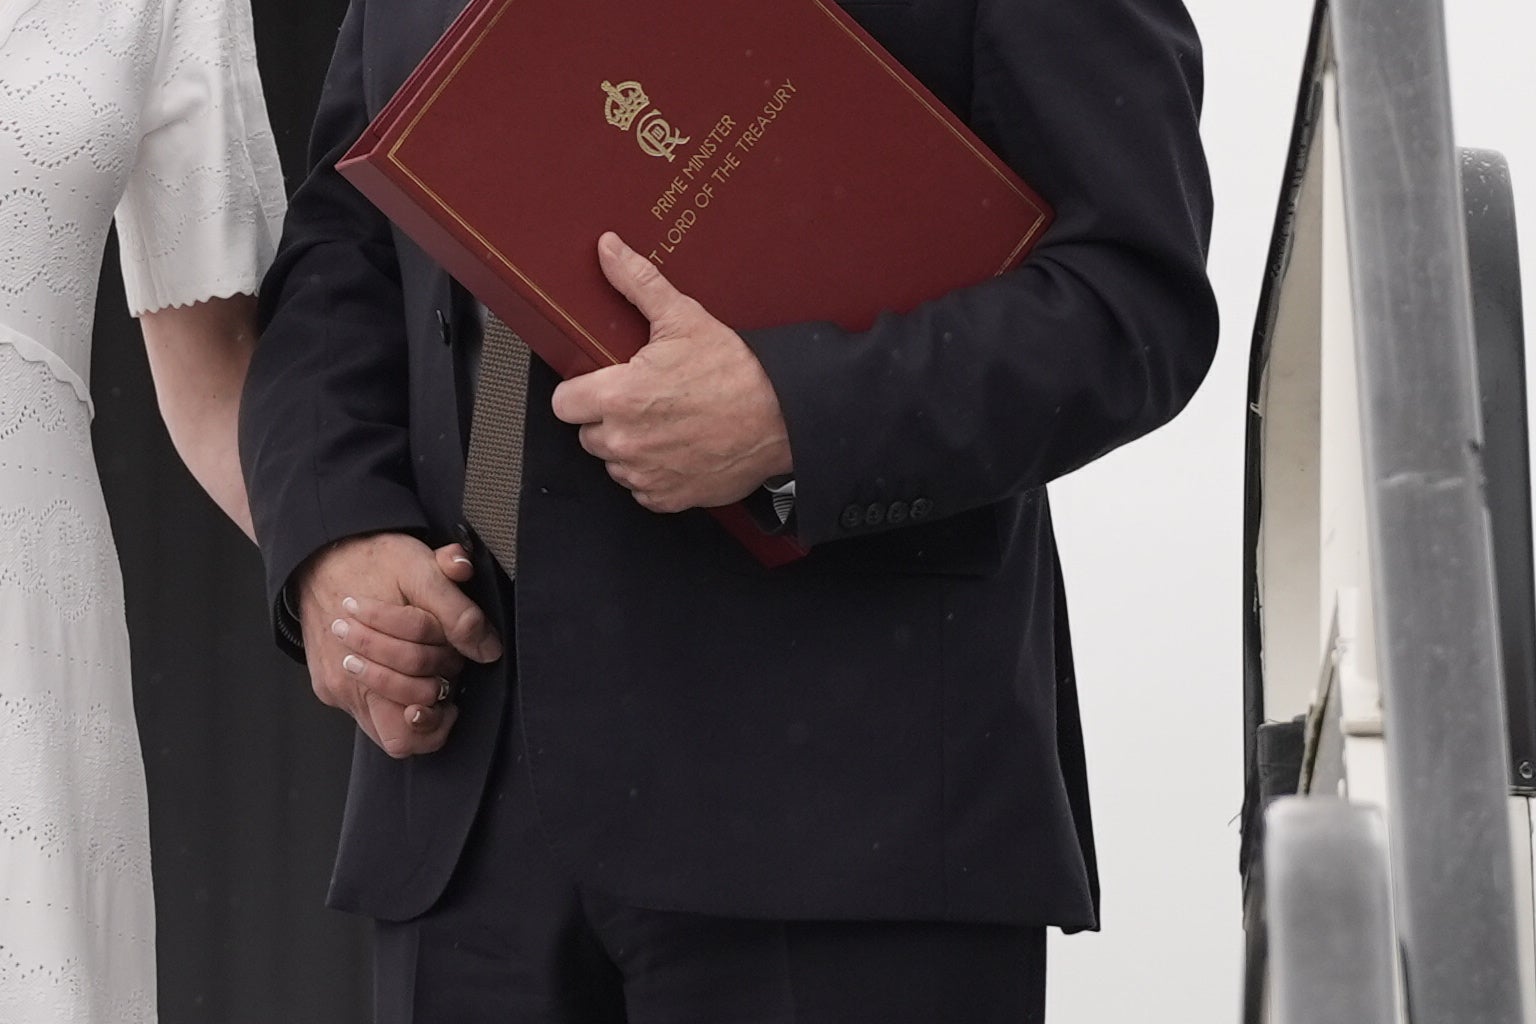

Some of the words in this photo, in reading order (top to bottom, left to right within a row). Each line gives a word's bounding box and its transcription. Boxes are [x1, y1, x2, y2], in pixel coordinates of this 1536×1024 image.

[651, 176, 688, 220] PRIME
[682, 114, 737, 180] MINISTER
[660, 209, 697, 253] LORD
[694, 183, 715, 208] OF
[711, 152, 741, 183] THE
[735, 78, 797, 153] TREASURY
